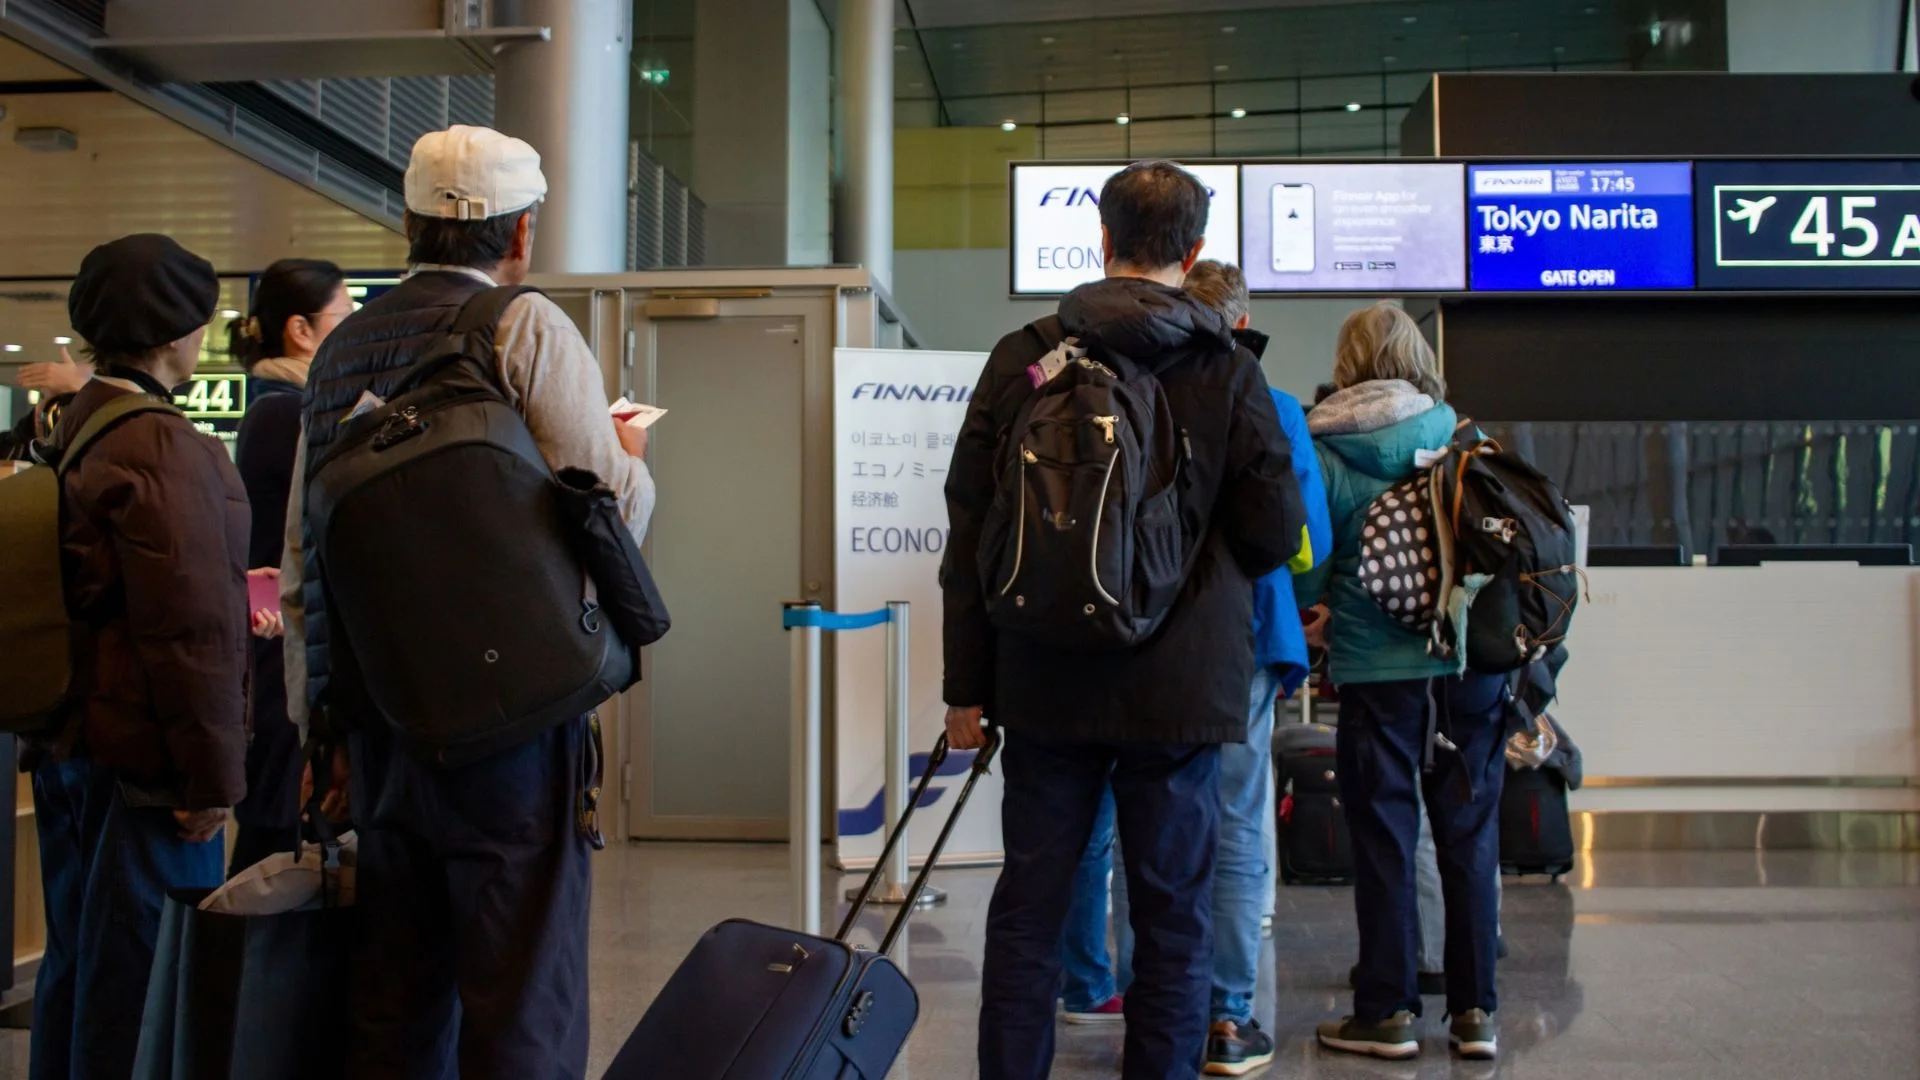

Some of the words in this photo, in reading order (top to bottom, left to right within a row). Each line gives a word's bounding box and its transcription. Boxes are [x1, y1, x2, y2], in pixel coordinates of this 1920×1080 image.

[1591, 177, 1635, 192] 17:45
[1477, 204, 1561, 236] Tokyo
[1570, 203, 1658, 230] Narita
[1790, 196, 1879, 257] 45
[1479, 235, 1514, 254] 東京
[1038, 247, 1103, 269] ECON
[1541, 270, 1576, 286] GATE
[1578, 269, 1616, 286] OPEN
[852, 383, 975, 402] FINNAI
[851, 431, 917, 448] 이코노미
[926, 431, 956, 449] 클래
[852, 461, 946, 478] エコノミー
[852, 527, 950, 553] ECONO
